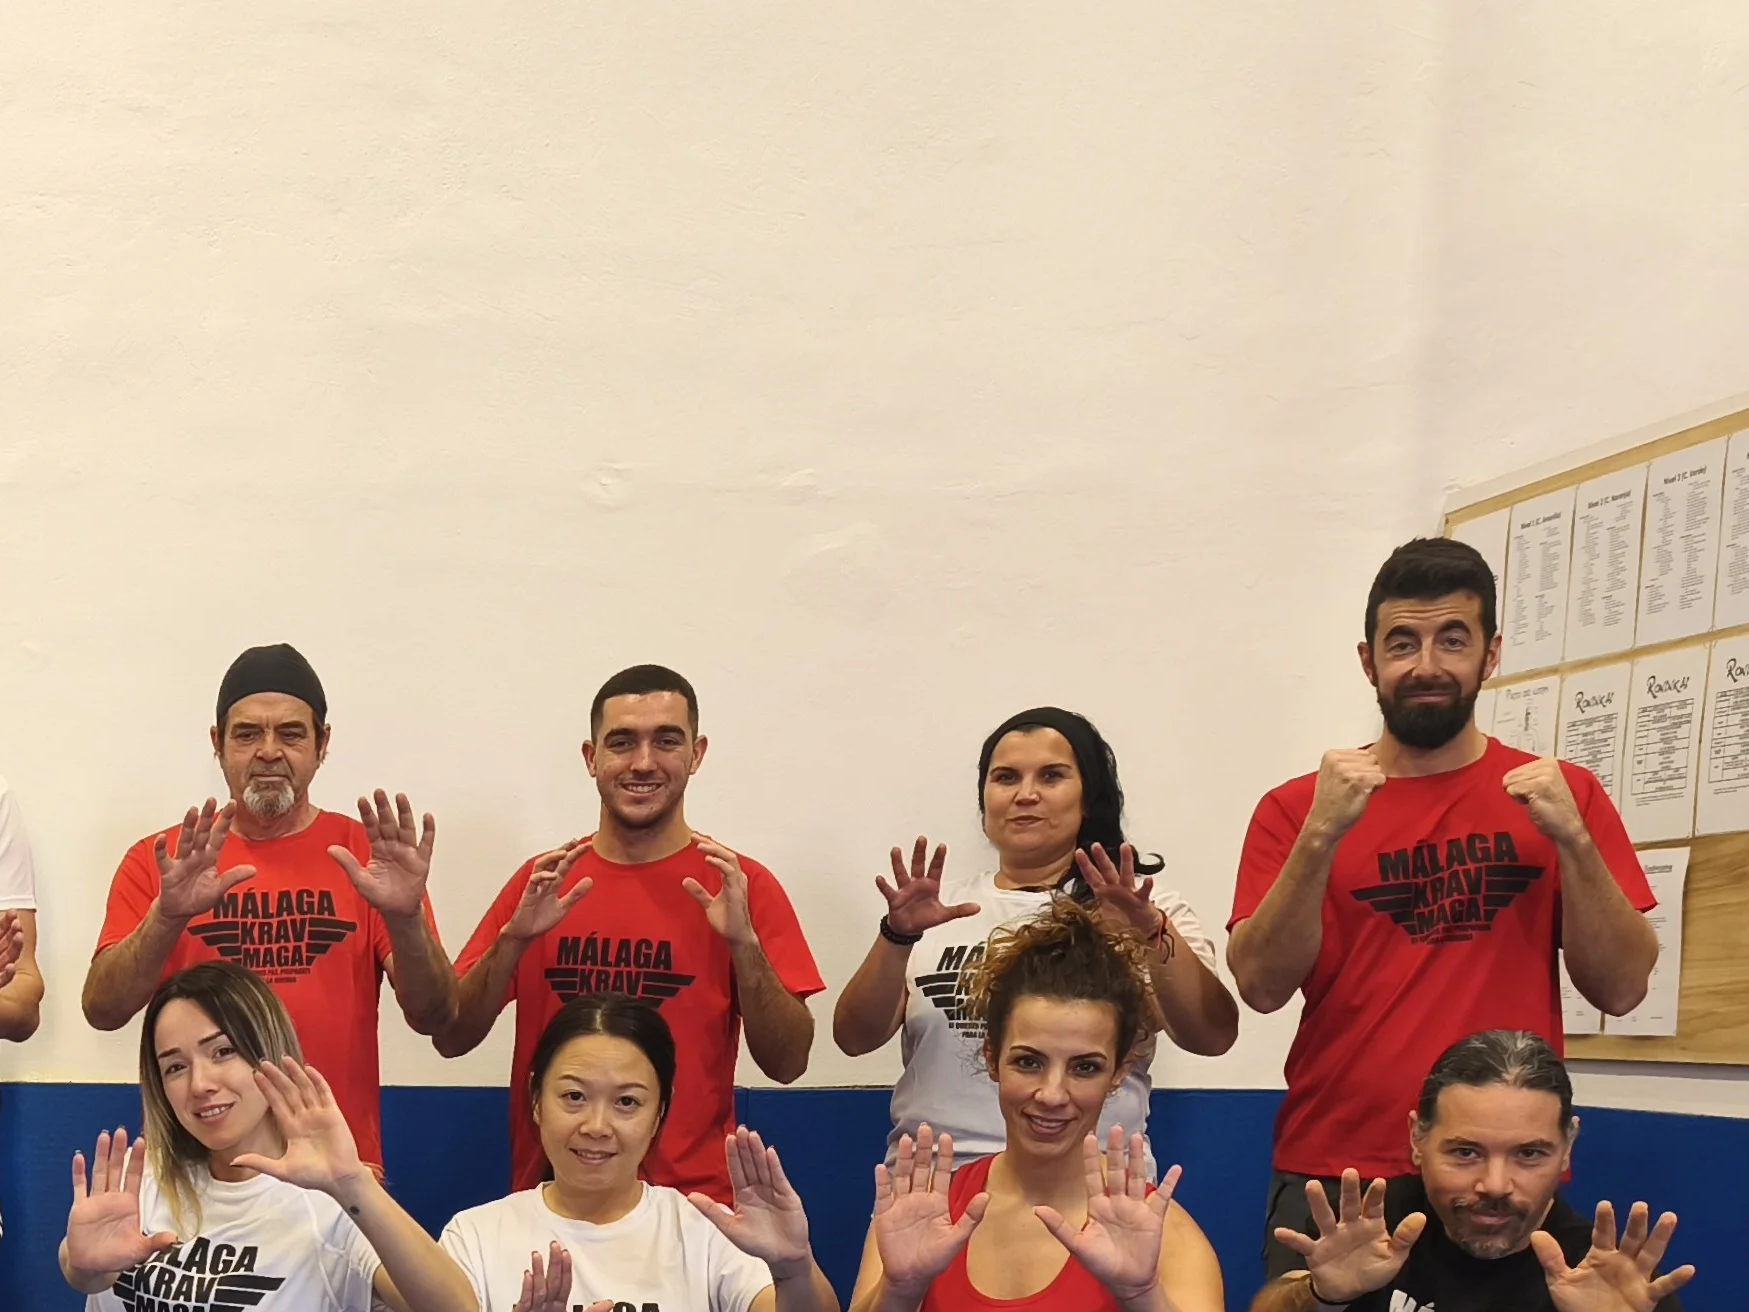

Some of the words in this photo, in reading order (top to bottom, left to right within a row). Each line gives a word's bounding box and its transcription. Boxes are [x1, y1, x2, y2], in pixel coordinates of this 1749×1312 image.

[1377, 831, 1519, 883] MÁLAGA
[212, 888, 337, 920] MÁLAGA
[1413, 867, 1484, 910] KRAV
[240, 918, 309, 946] KRAV
[1415, 896, 1482, 934] MAGA
[242, 945, 304, 968] MAGA
[557, 931, 672, 971] MÁLAGA
[579, 968, 645, 997] KRAV
[141, 1236, 258, 1275] LAGA
[135, 1264, 220, 1304] KRAV
